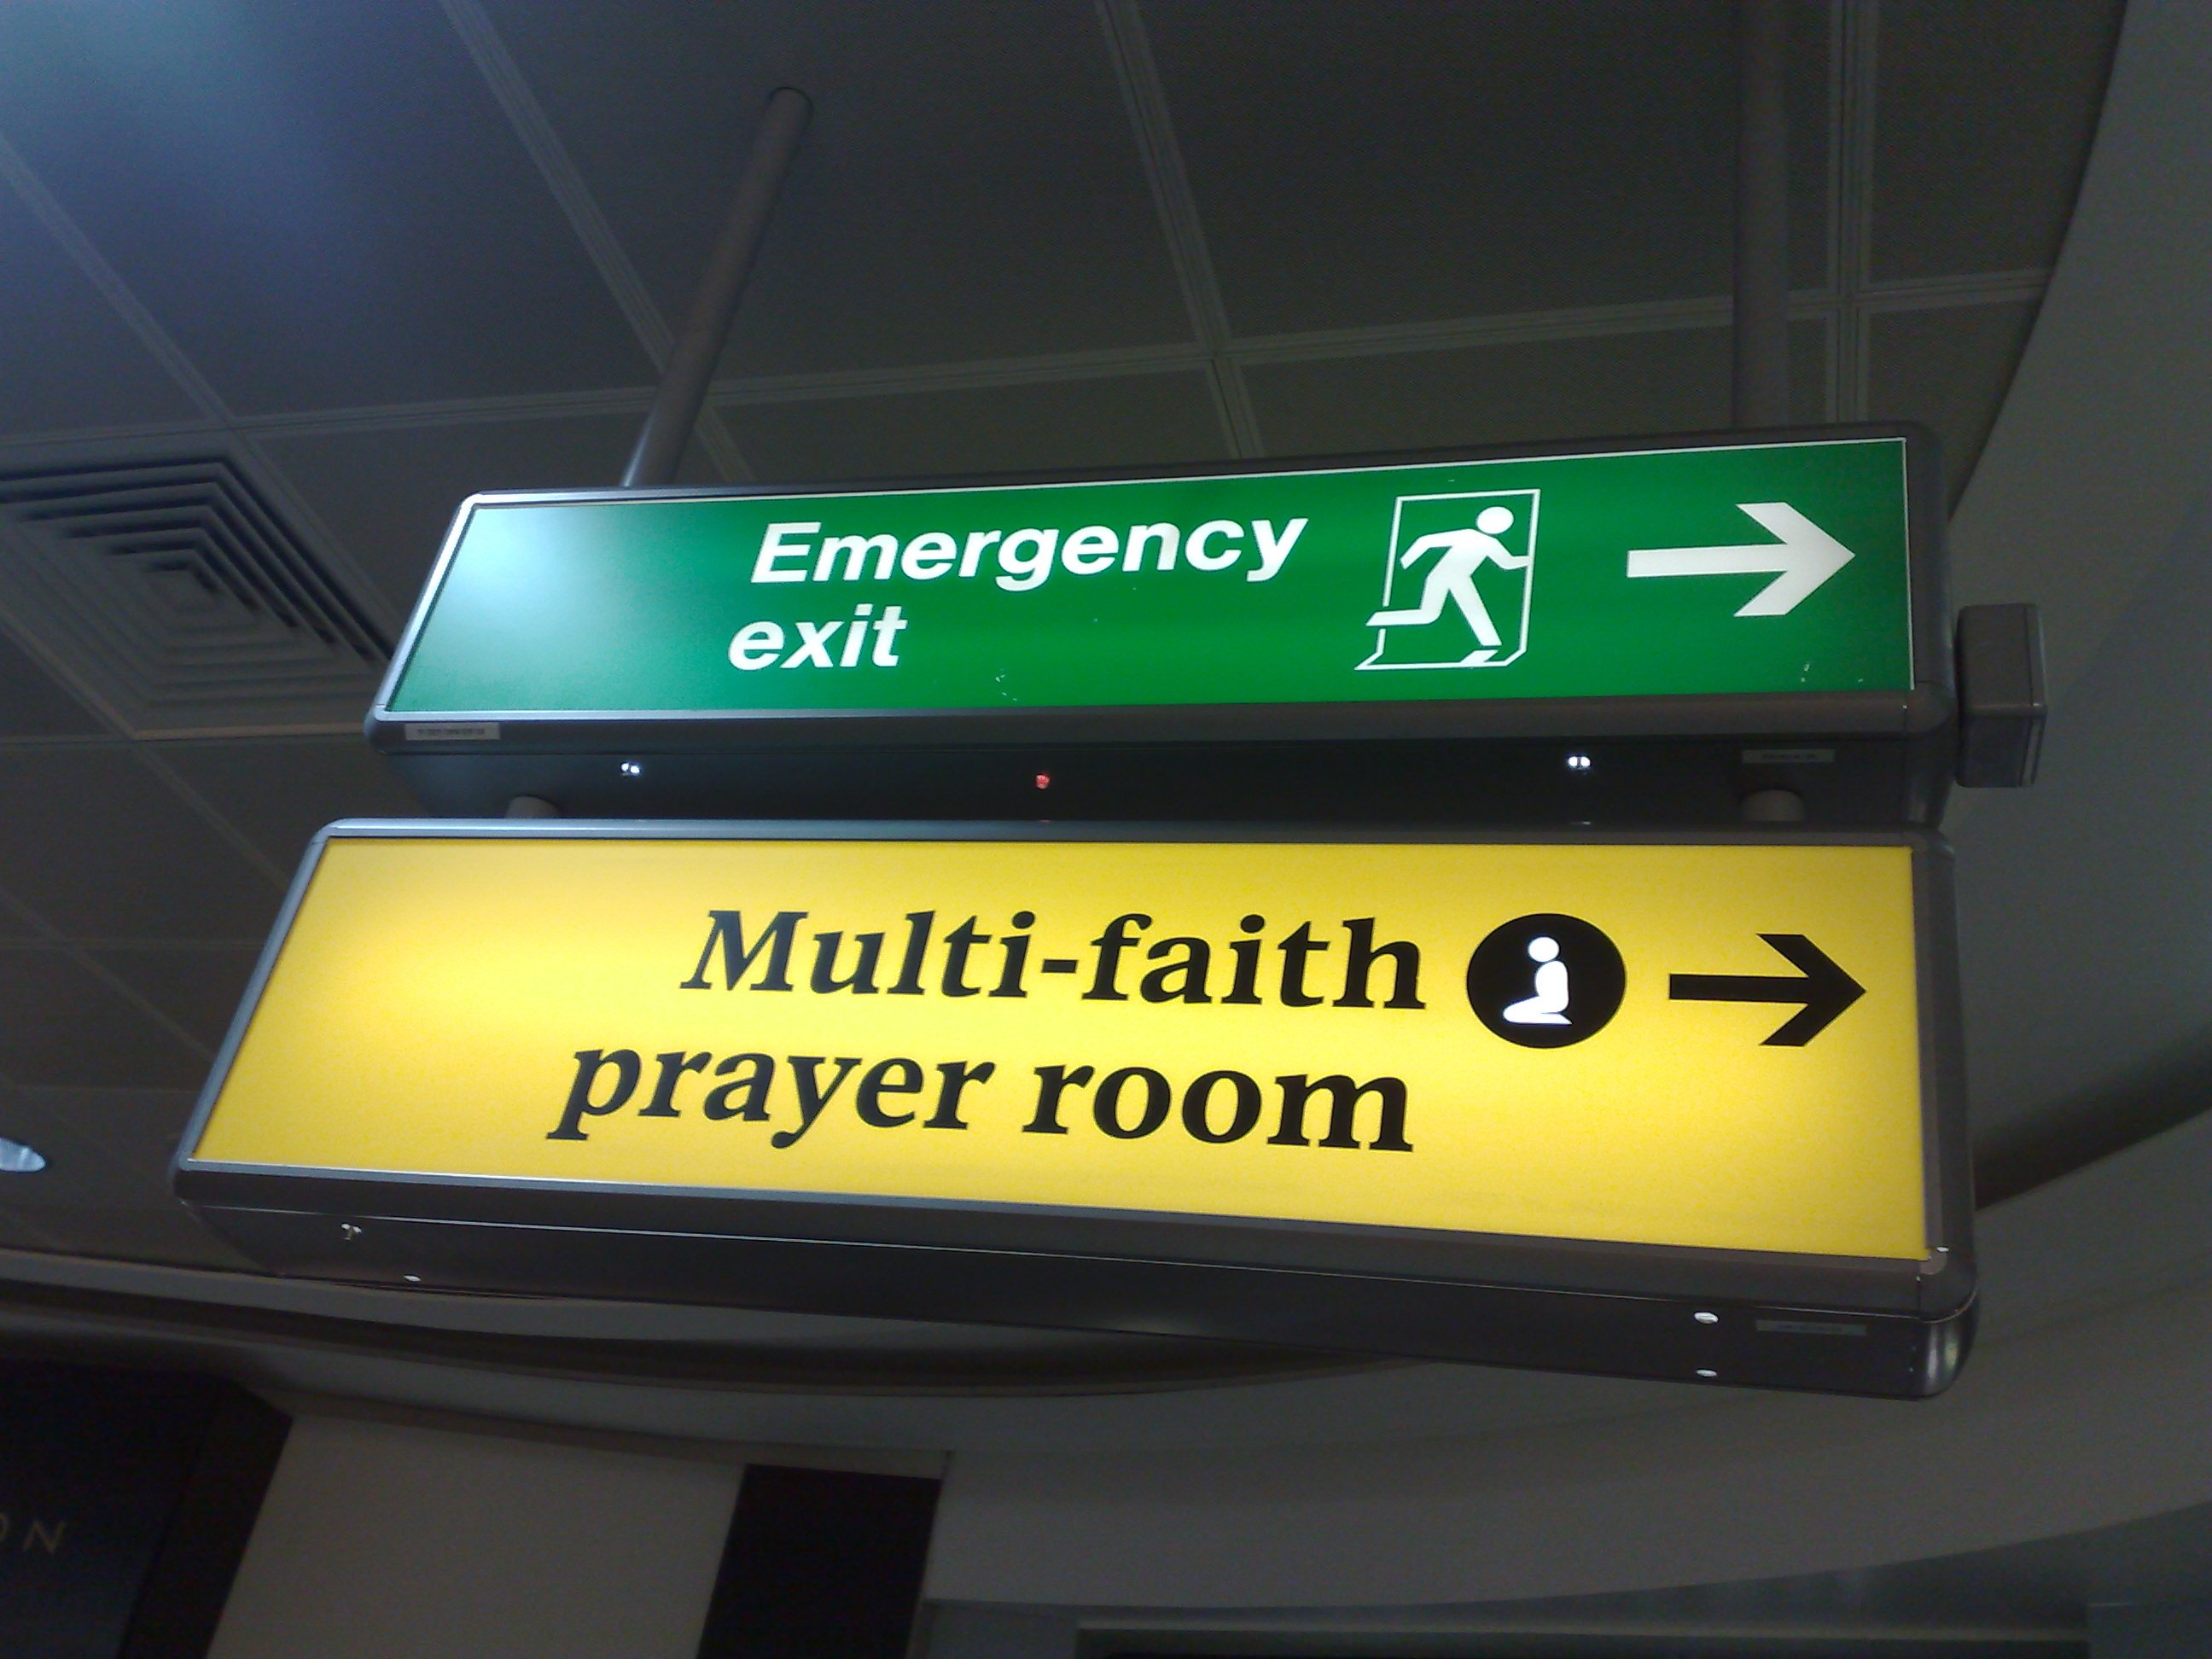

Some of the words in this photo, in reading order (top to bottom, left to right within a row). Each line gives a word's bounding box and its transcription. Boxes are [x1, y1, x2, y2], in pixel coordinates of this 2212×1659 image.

[751, 517, 1307, 591] Emergency
[728, 603, 907, 671] exit
[680, 909, 1426, 1010] Multi-faith
[547, 1047, 994, 1148] prayer
[1022, 1063, 1413, 1152] room
